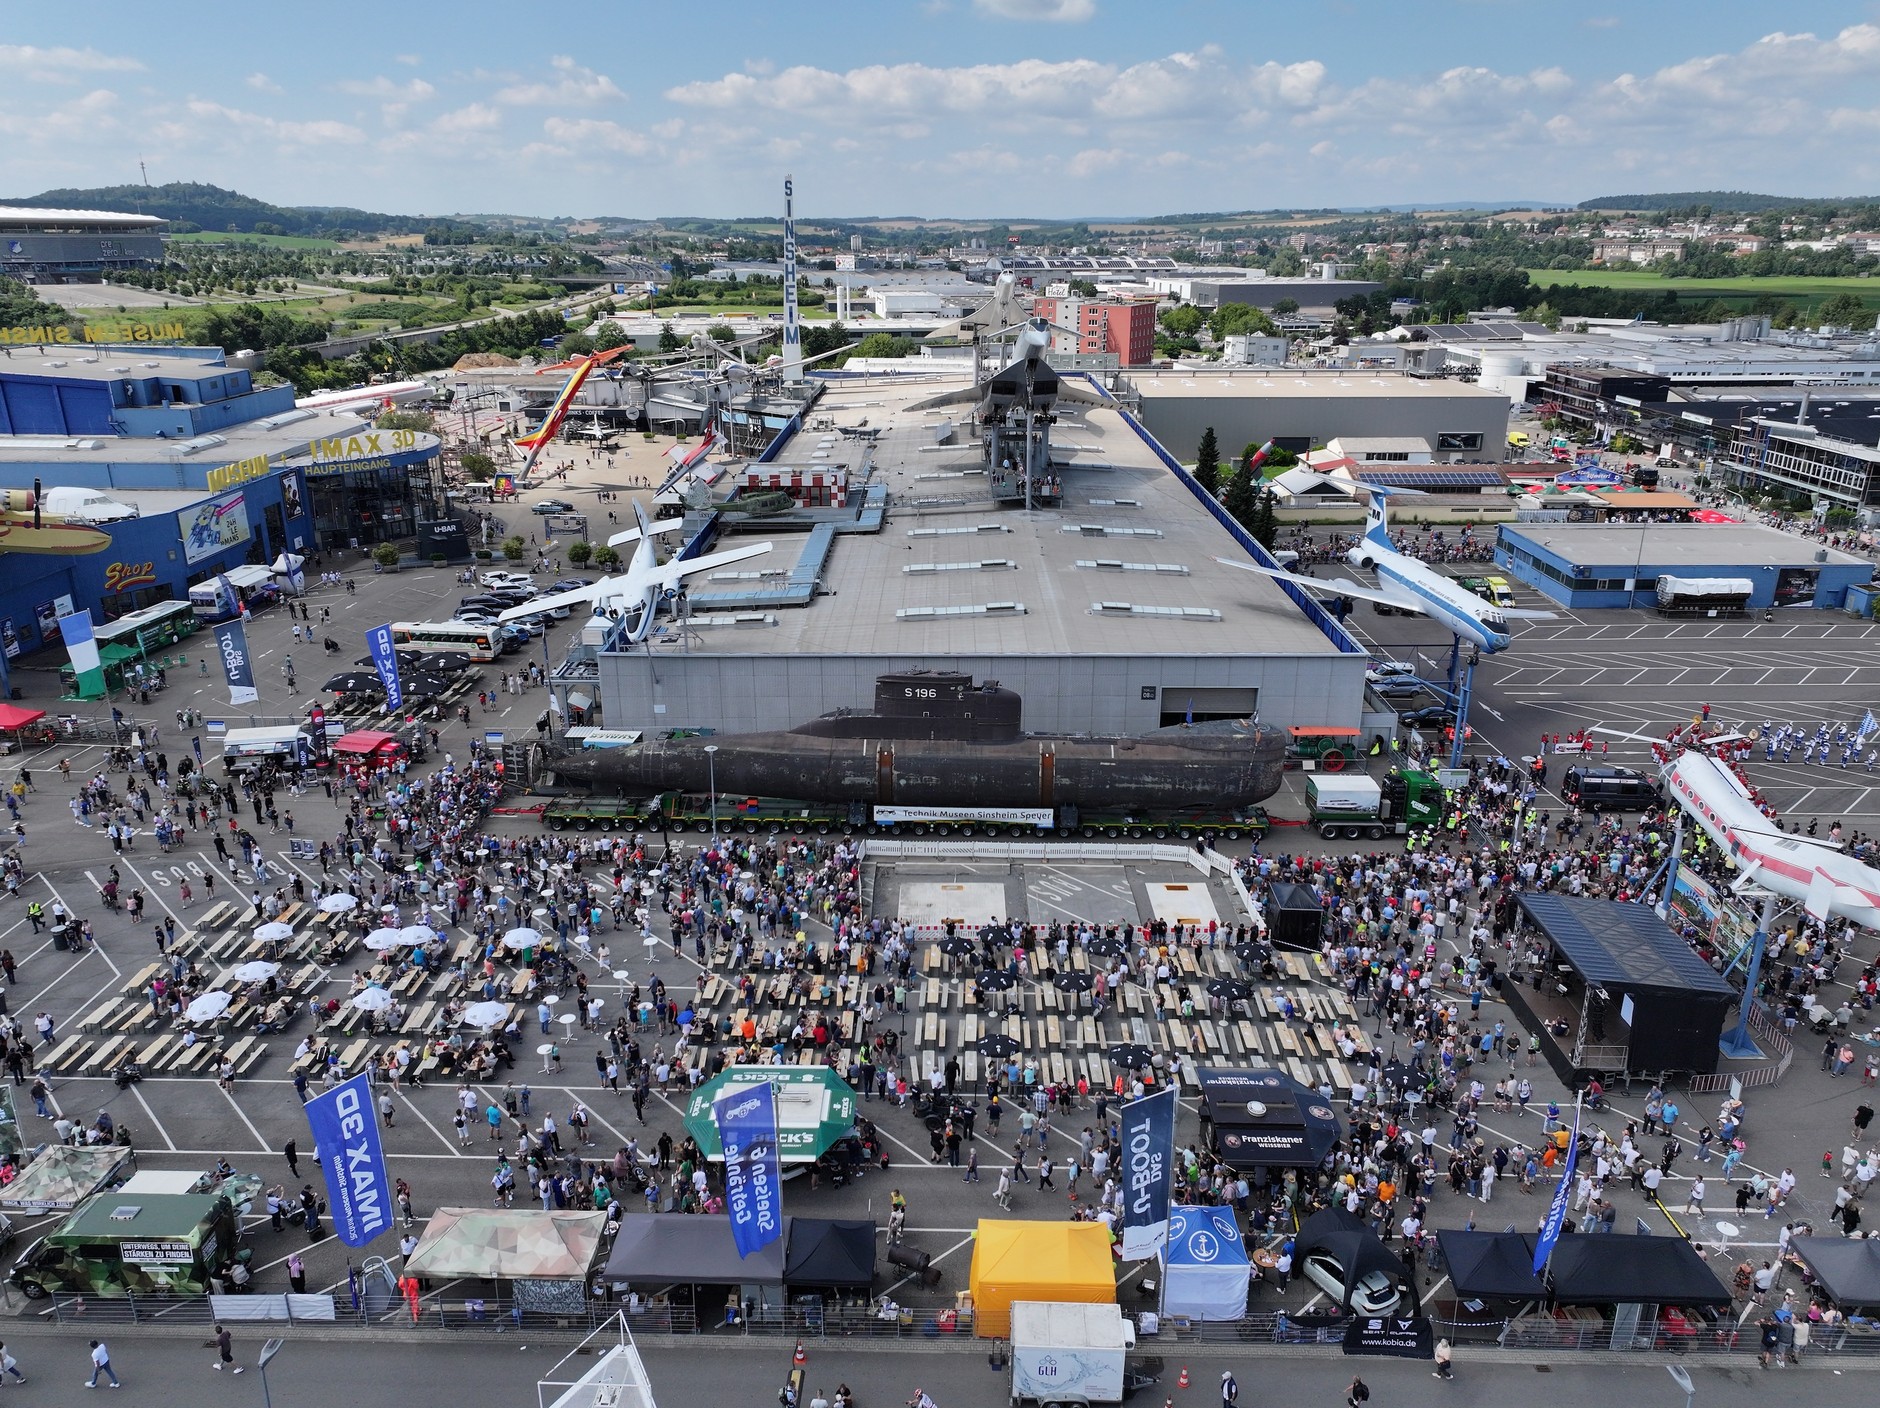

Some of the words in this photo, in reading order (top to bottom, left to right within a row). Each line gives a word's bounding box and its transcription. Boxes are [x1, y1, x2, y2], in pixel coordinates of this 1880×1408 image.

[784, 180, 800, 345] SINSHEIM
[1047, 287, 1066, 297] Hotel
[206, 453, 270, 494] MUSEUM
[309, 433, 384, 460] IMAX
[392, 428, 416, 450] 3D
[304, 458, 391, 476] HAUPTEINGANG
[226, 520, 237, 528] 24H
[434, 524, 456, 533] U-BAR
[104, 562, 154, 589] Shop
[904, 688, 912, 697] S
[914, 688, 937, 698] 196
[902, 809, 938, 817] Technik
[940, 810, 975, 818] Museen
[977, 811, 1018, 819] Sinsheim
[1020, 812, 1052, 821] Speyer
[152, 861, 206, 886] BUS
[1242, 1135, 1304, 1144] Franziskaner
[1362, 1338, 1417, 1348] www.kobia.de
[1038, 1366, 1057, 1376] GLH
